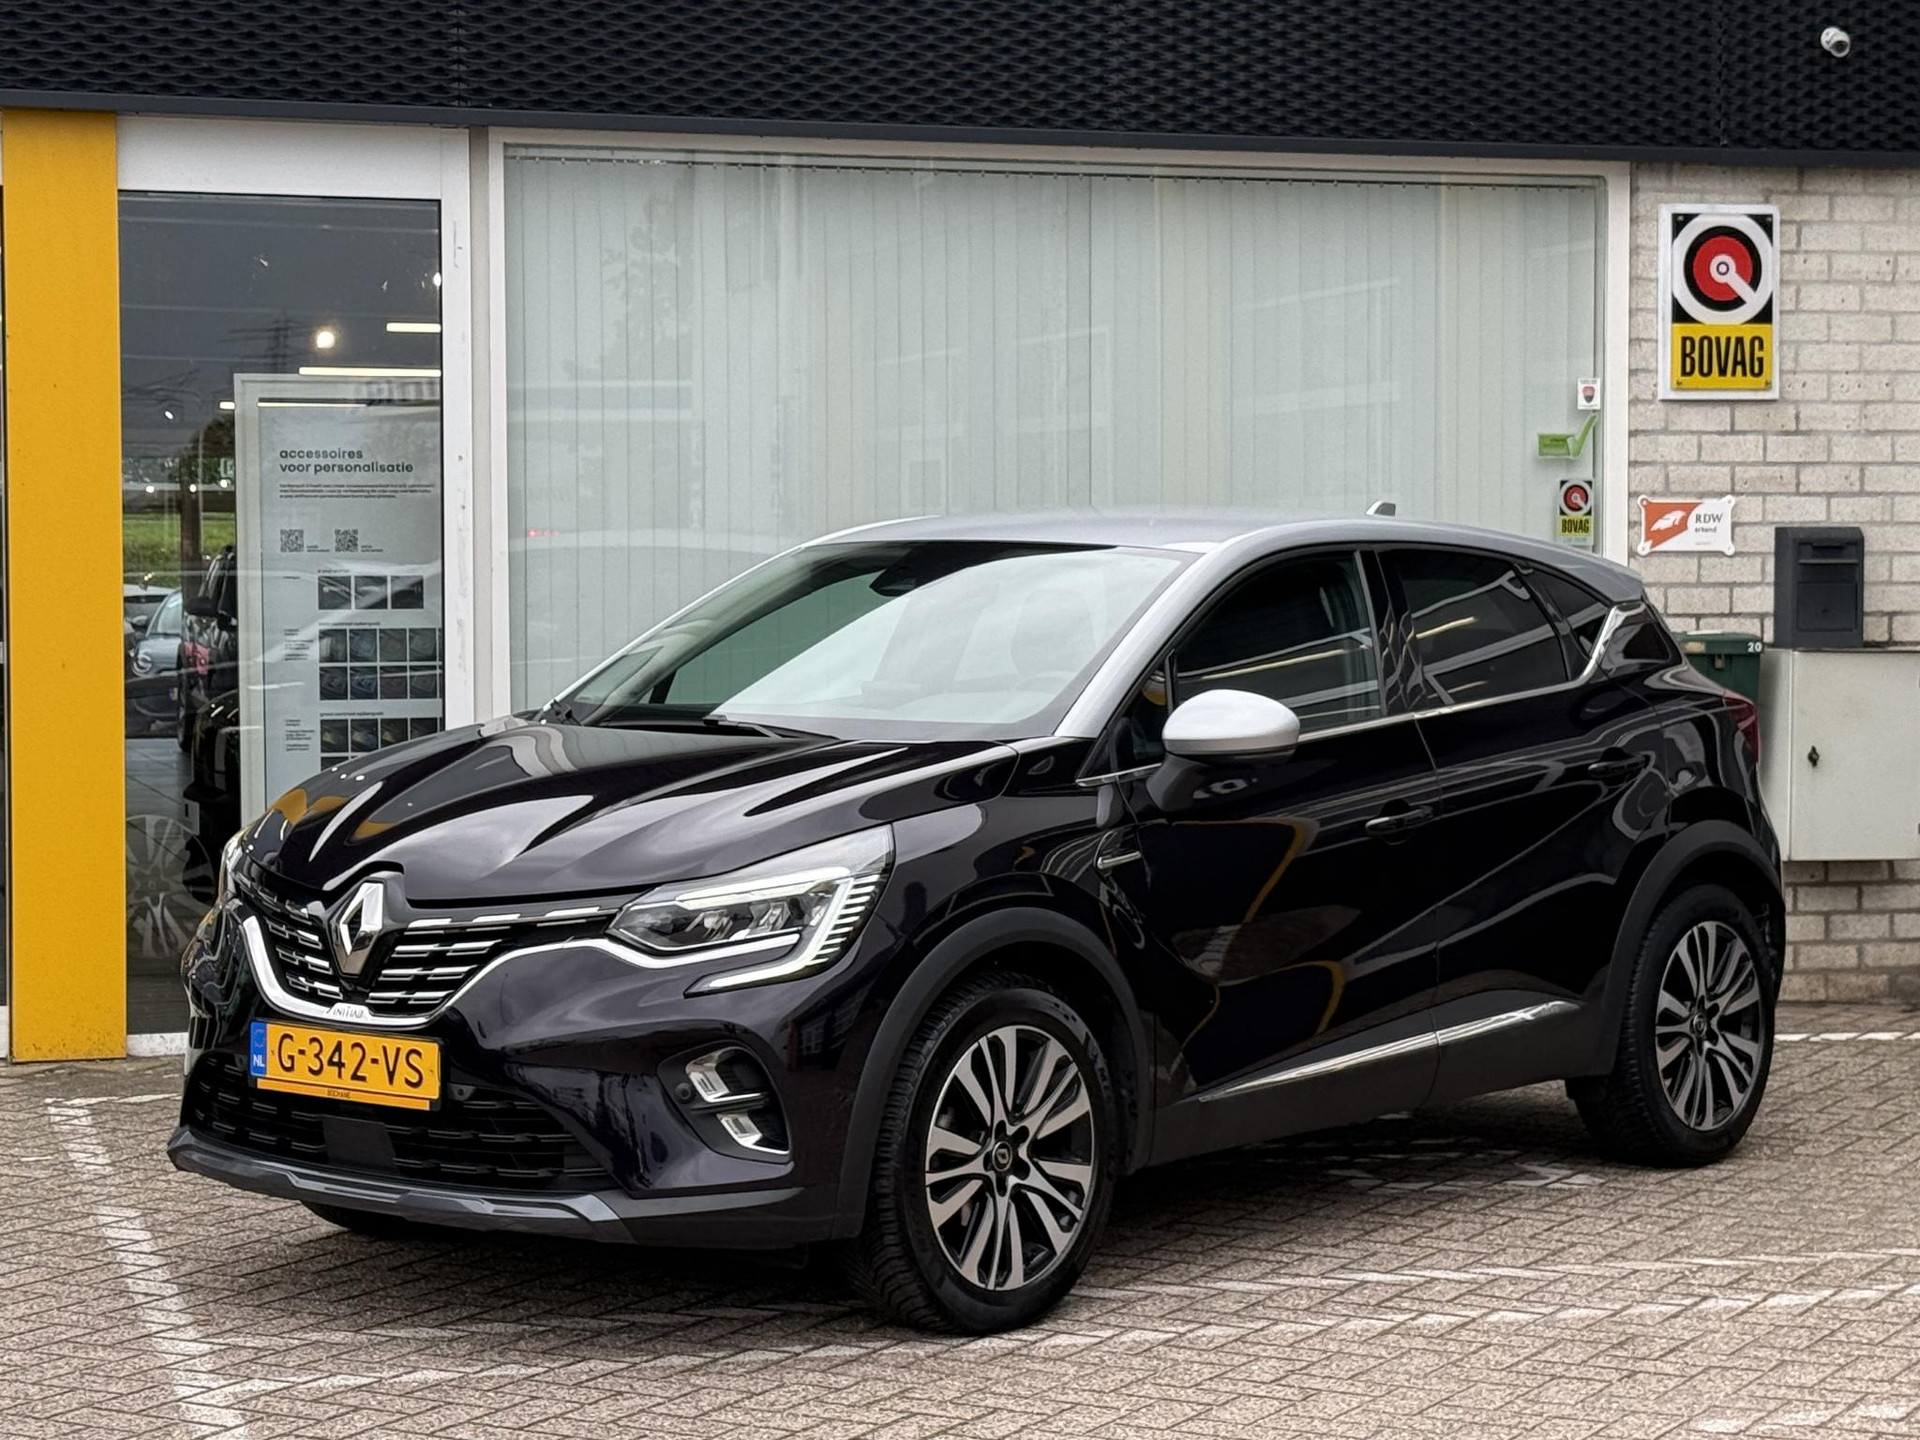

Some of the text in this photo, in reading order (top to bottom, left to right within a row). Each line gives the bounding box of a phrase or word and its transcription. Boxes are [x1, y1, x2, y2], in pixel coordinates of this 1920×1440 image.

[1681, 335, 1764, 377] BOVAG
[279, 448, 363, 459] accessoires
[279, 461, 413, 475] voor personalisatie
[1695, 513, 1723, 524] RDW
[1561, 518, 1589, 534] BOVAG
[1747, 642, 1762, 653] 20
[253, 1055, 265, 1067] NL
[277, 1033, 424, 1089] G-342-VS
